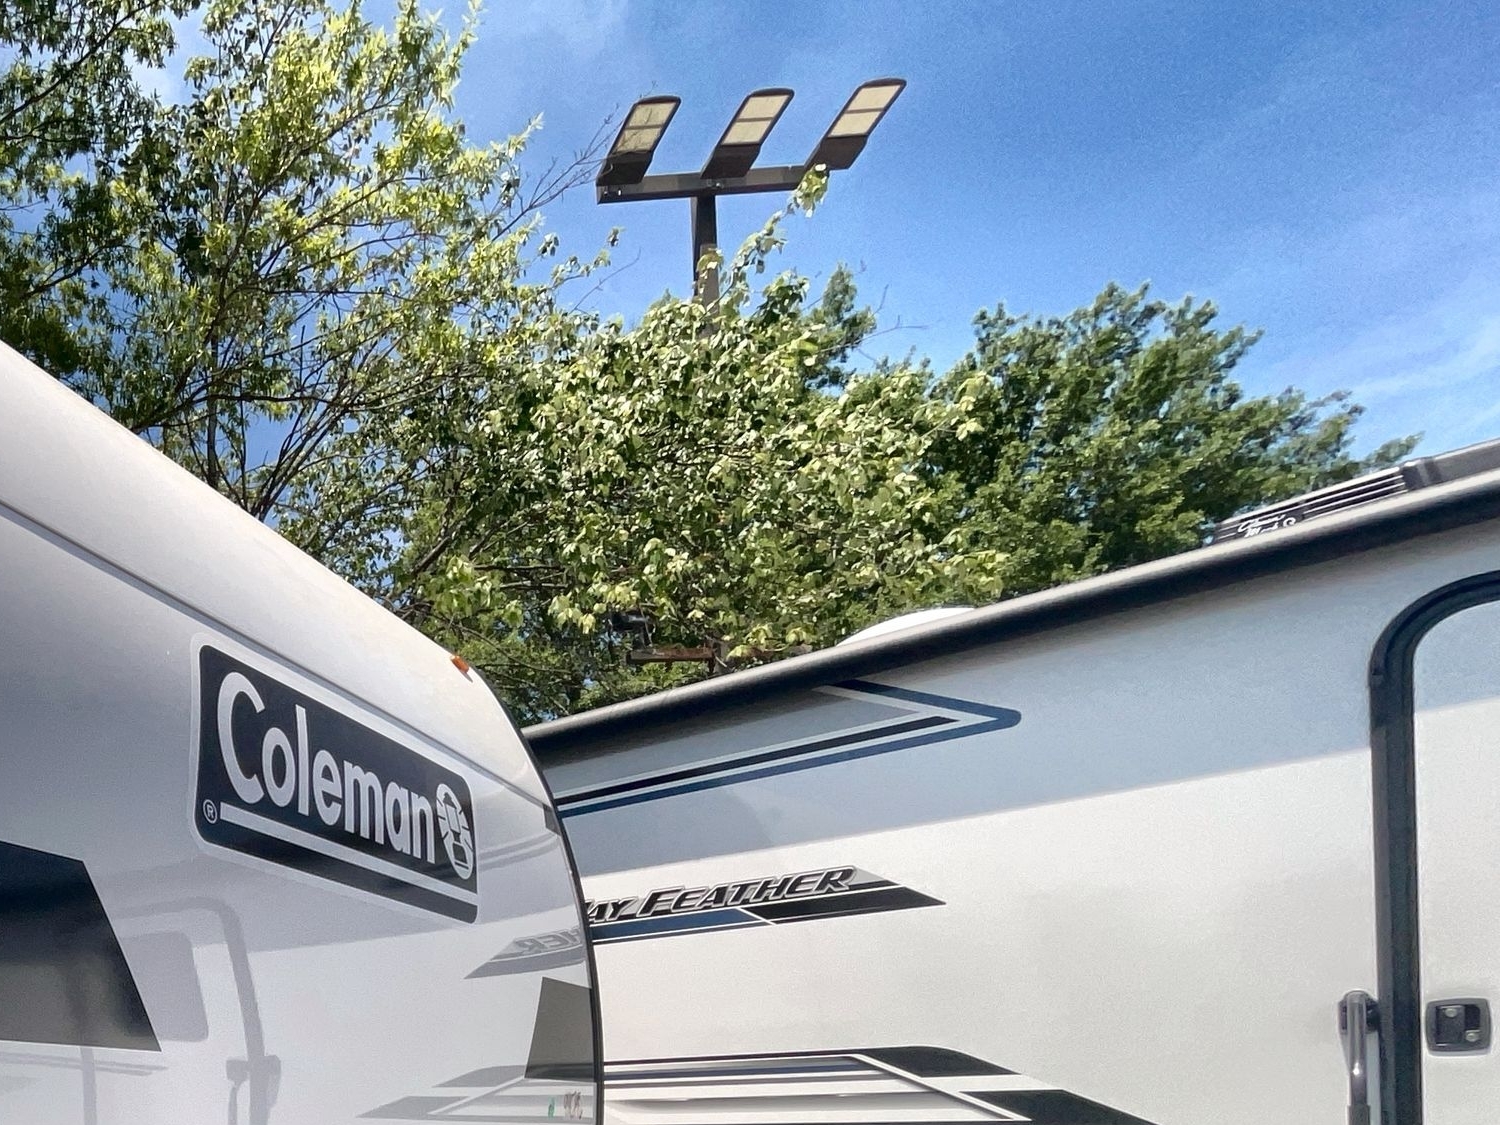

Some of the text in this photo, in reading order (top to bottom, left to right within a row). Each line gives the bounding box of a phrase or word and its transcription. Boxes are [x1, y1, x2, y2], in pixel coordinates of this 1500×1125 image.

[217, 671, 436, 864] Coleman
[585, 866, 854, 922] AY FEATHER
